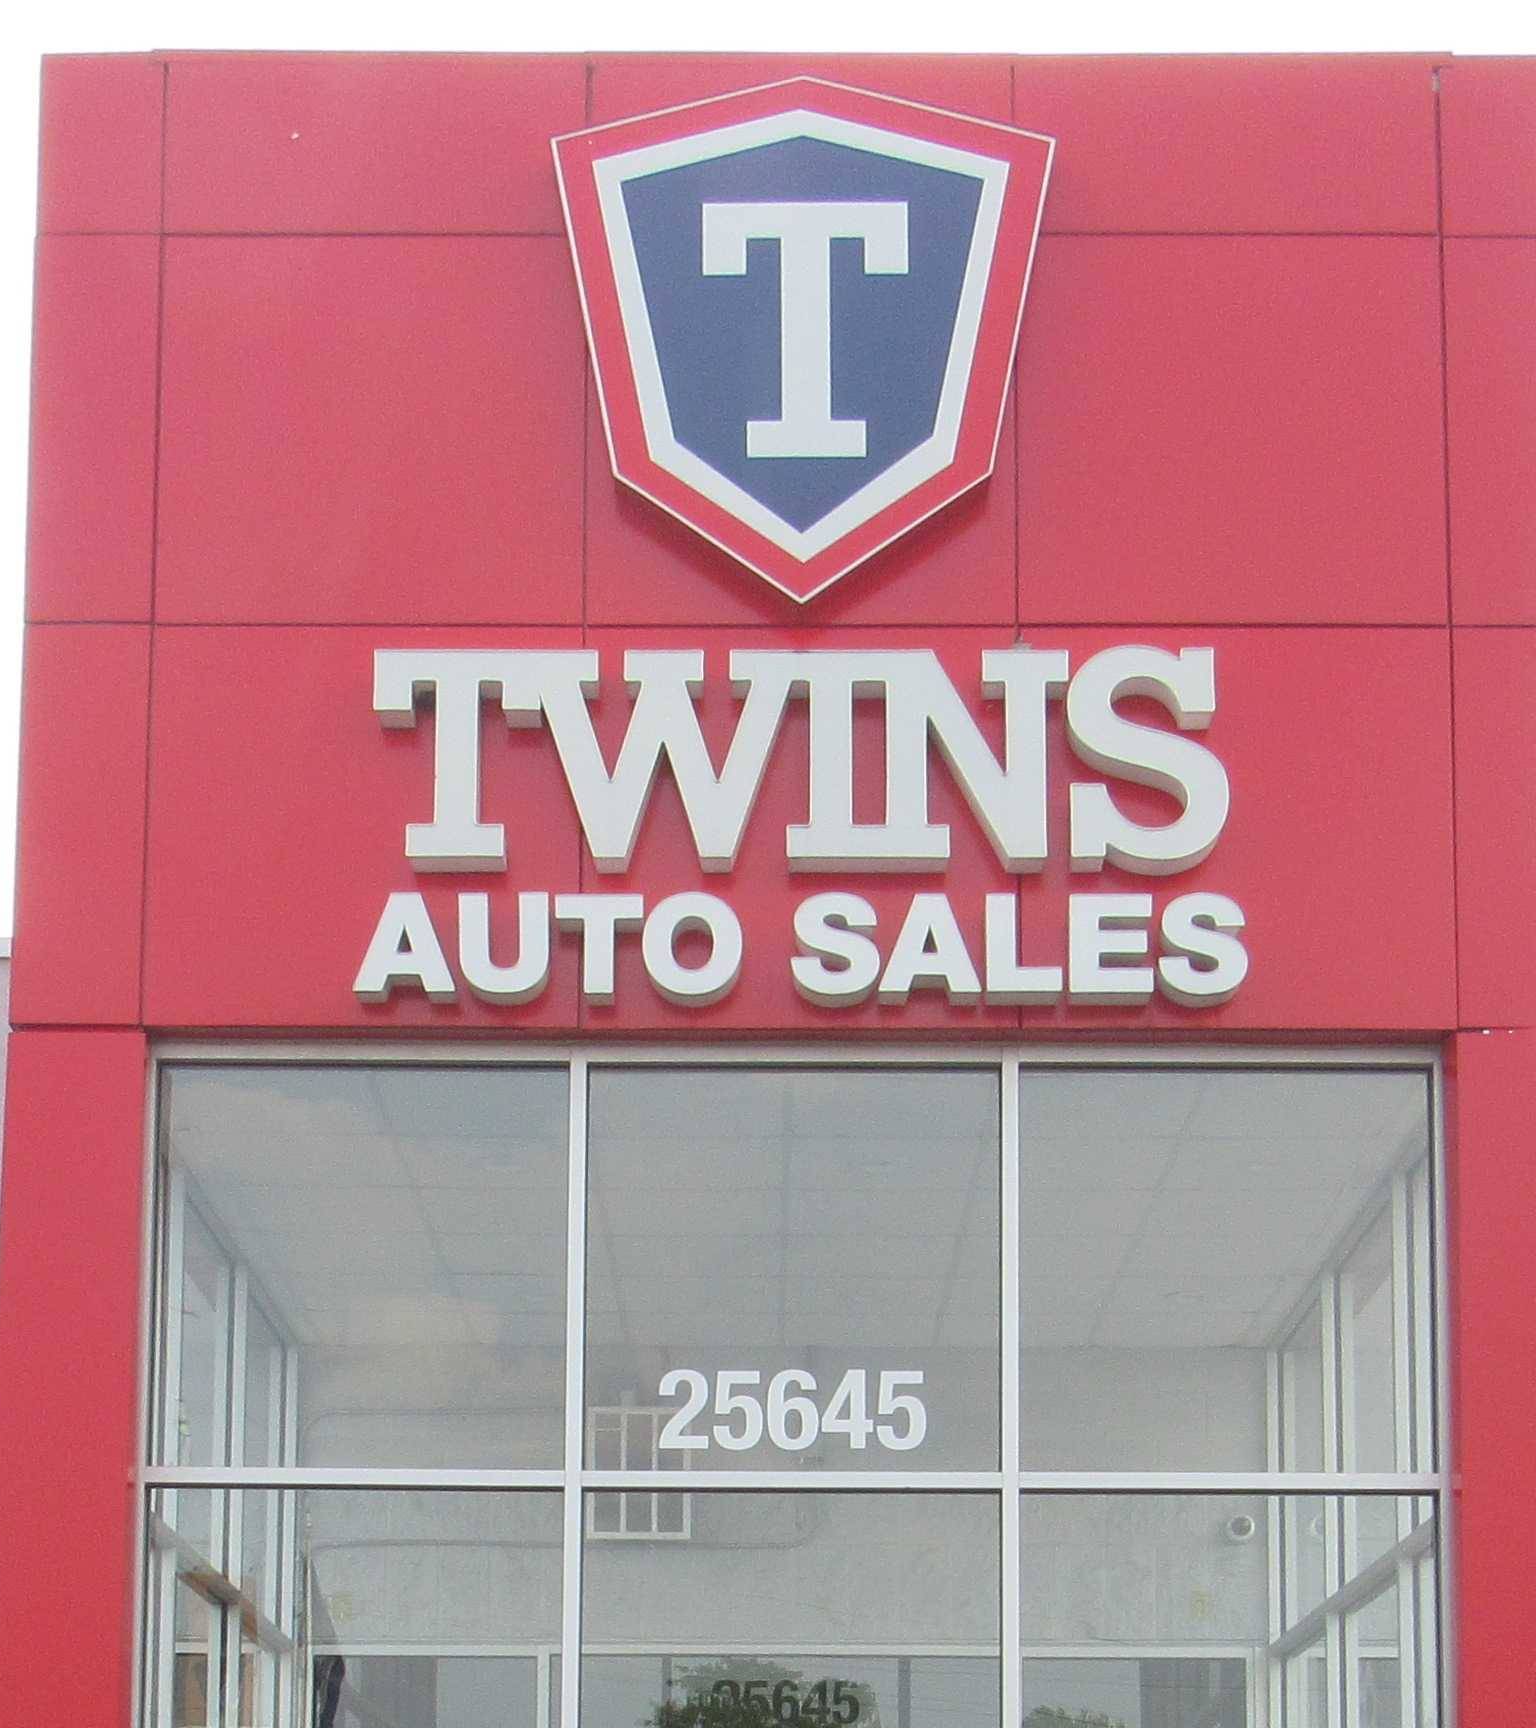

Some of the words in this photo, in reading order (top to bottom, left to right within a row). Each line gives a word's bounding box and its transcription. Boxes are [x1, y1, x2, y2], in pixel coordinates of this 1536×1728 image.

[701, 201, 909, 460] T
[372, 645, 1232, 875] TWINS
[352, 889, 744, 1007] AUTO
[790, 889, 1250, 1007] SALES
[657, 1368, 928, 1450] 25645
